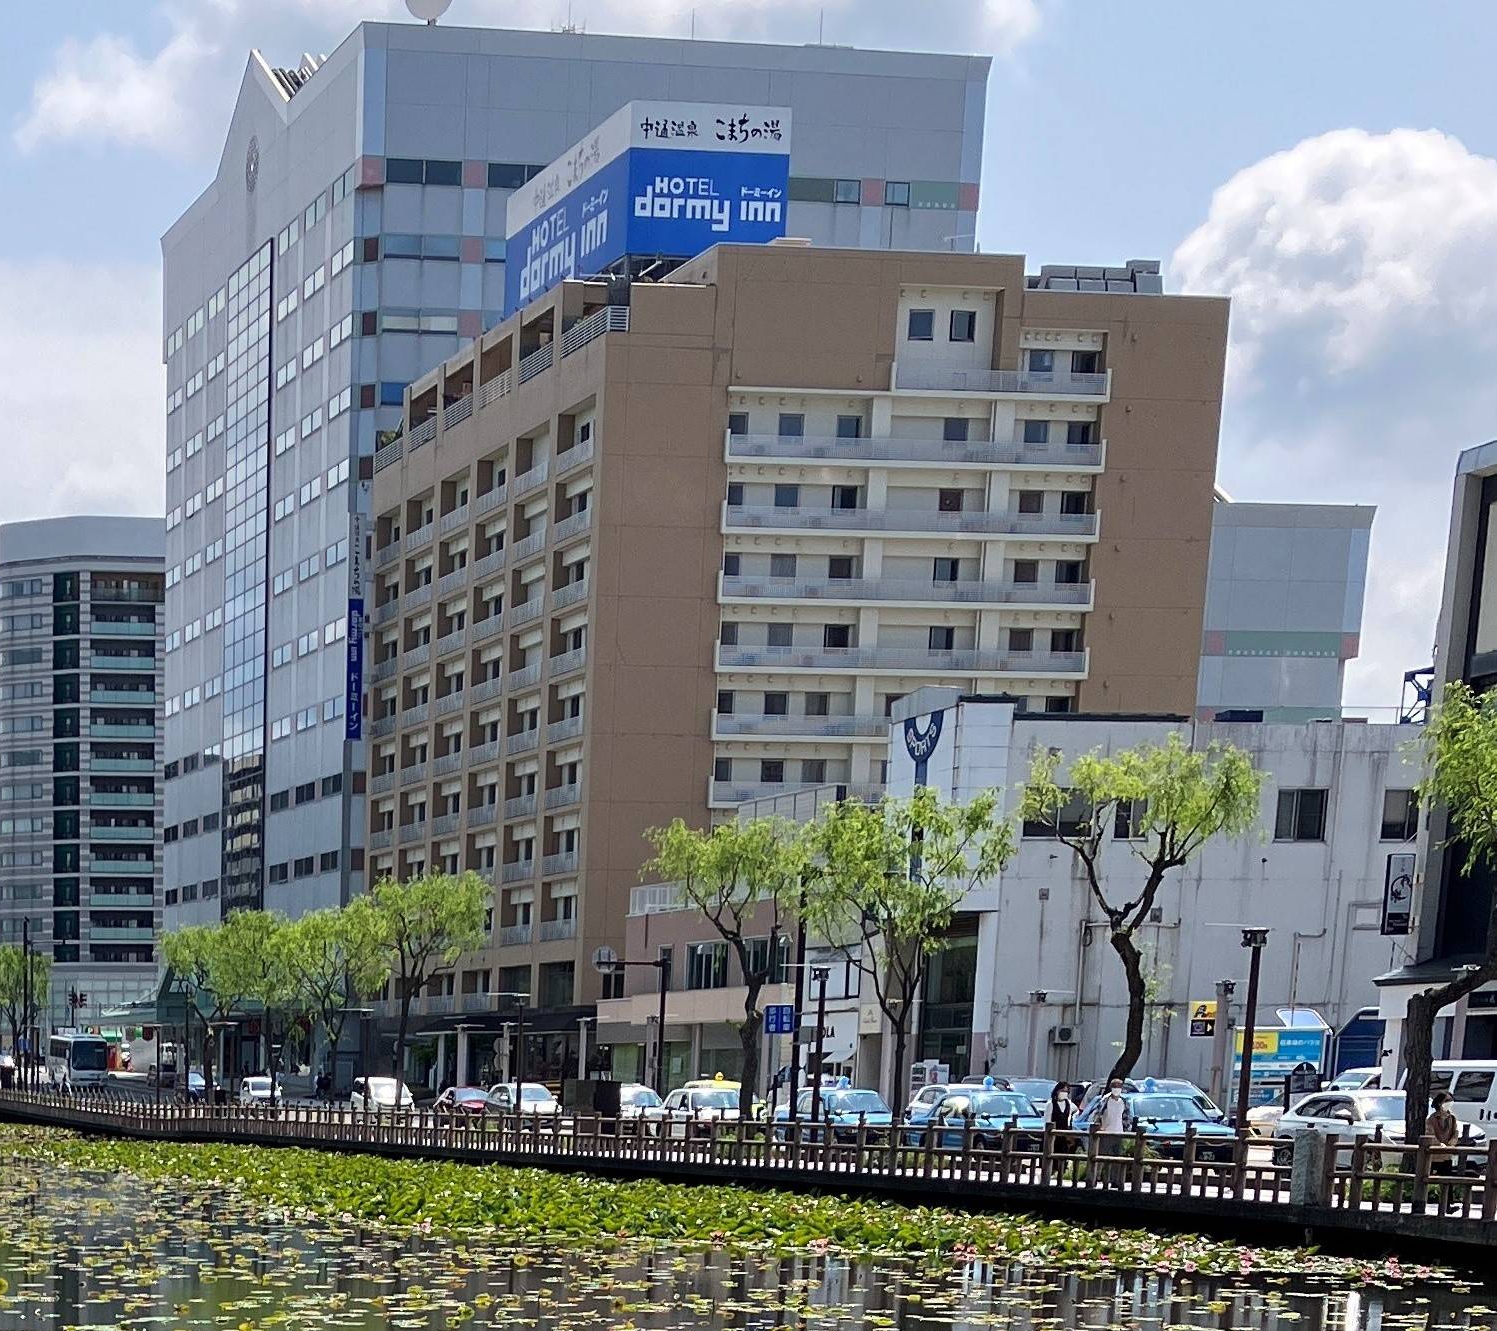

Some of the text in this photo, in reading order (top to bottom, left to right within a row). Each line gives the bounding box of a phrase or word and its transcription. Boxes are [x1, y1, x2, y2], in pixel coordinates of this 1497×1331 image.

[640, 113, 783, 144] 中通温泉 こまちの湯
[654, 176, 720, 196] HOTEL
[740, 186, 782, 199] ドーミーイン
[634, 185, 782, 232] dormy inn
[531, 207, 570, 256] HOTEL
[519, 209, 608, 301] dormy inn
[349, 671, 359, 731] ドーミーイン
[906, 722, 937, 756] SPORTS
